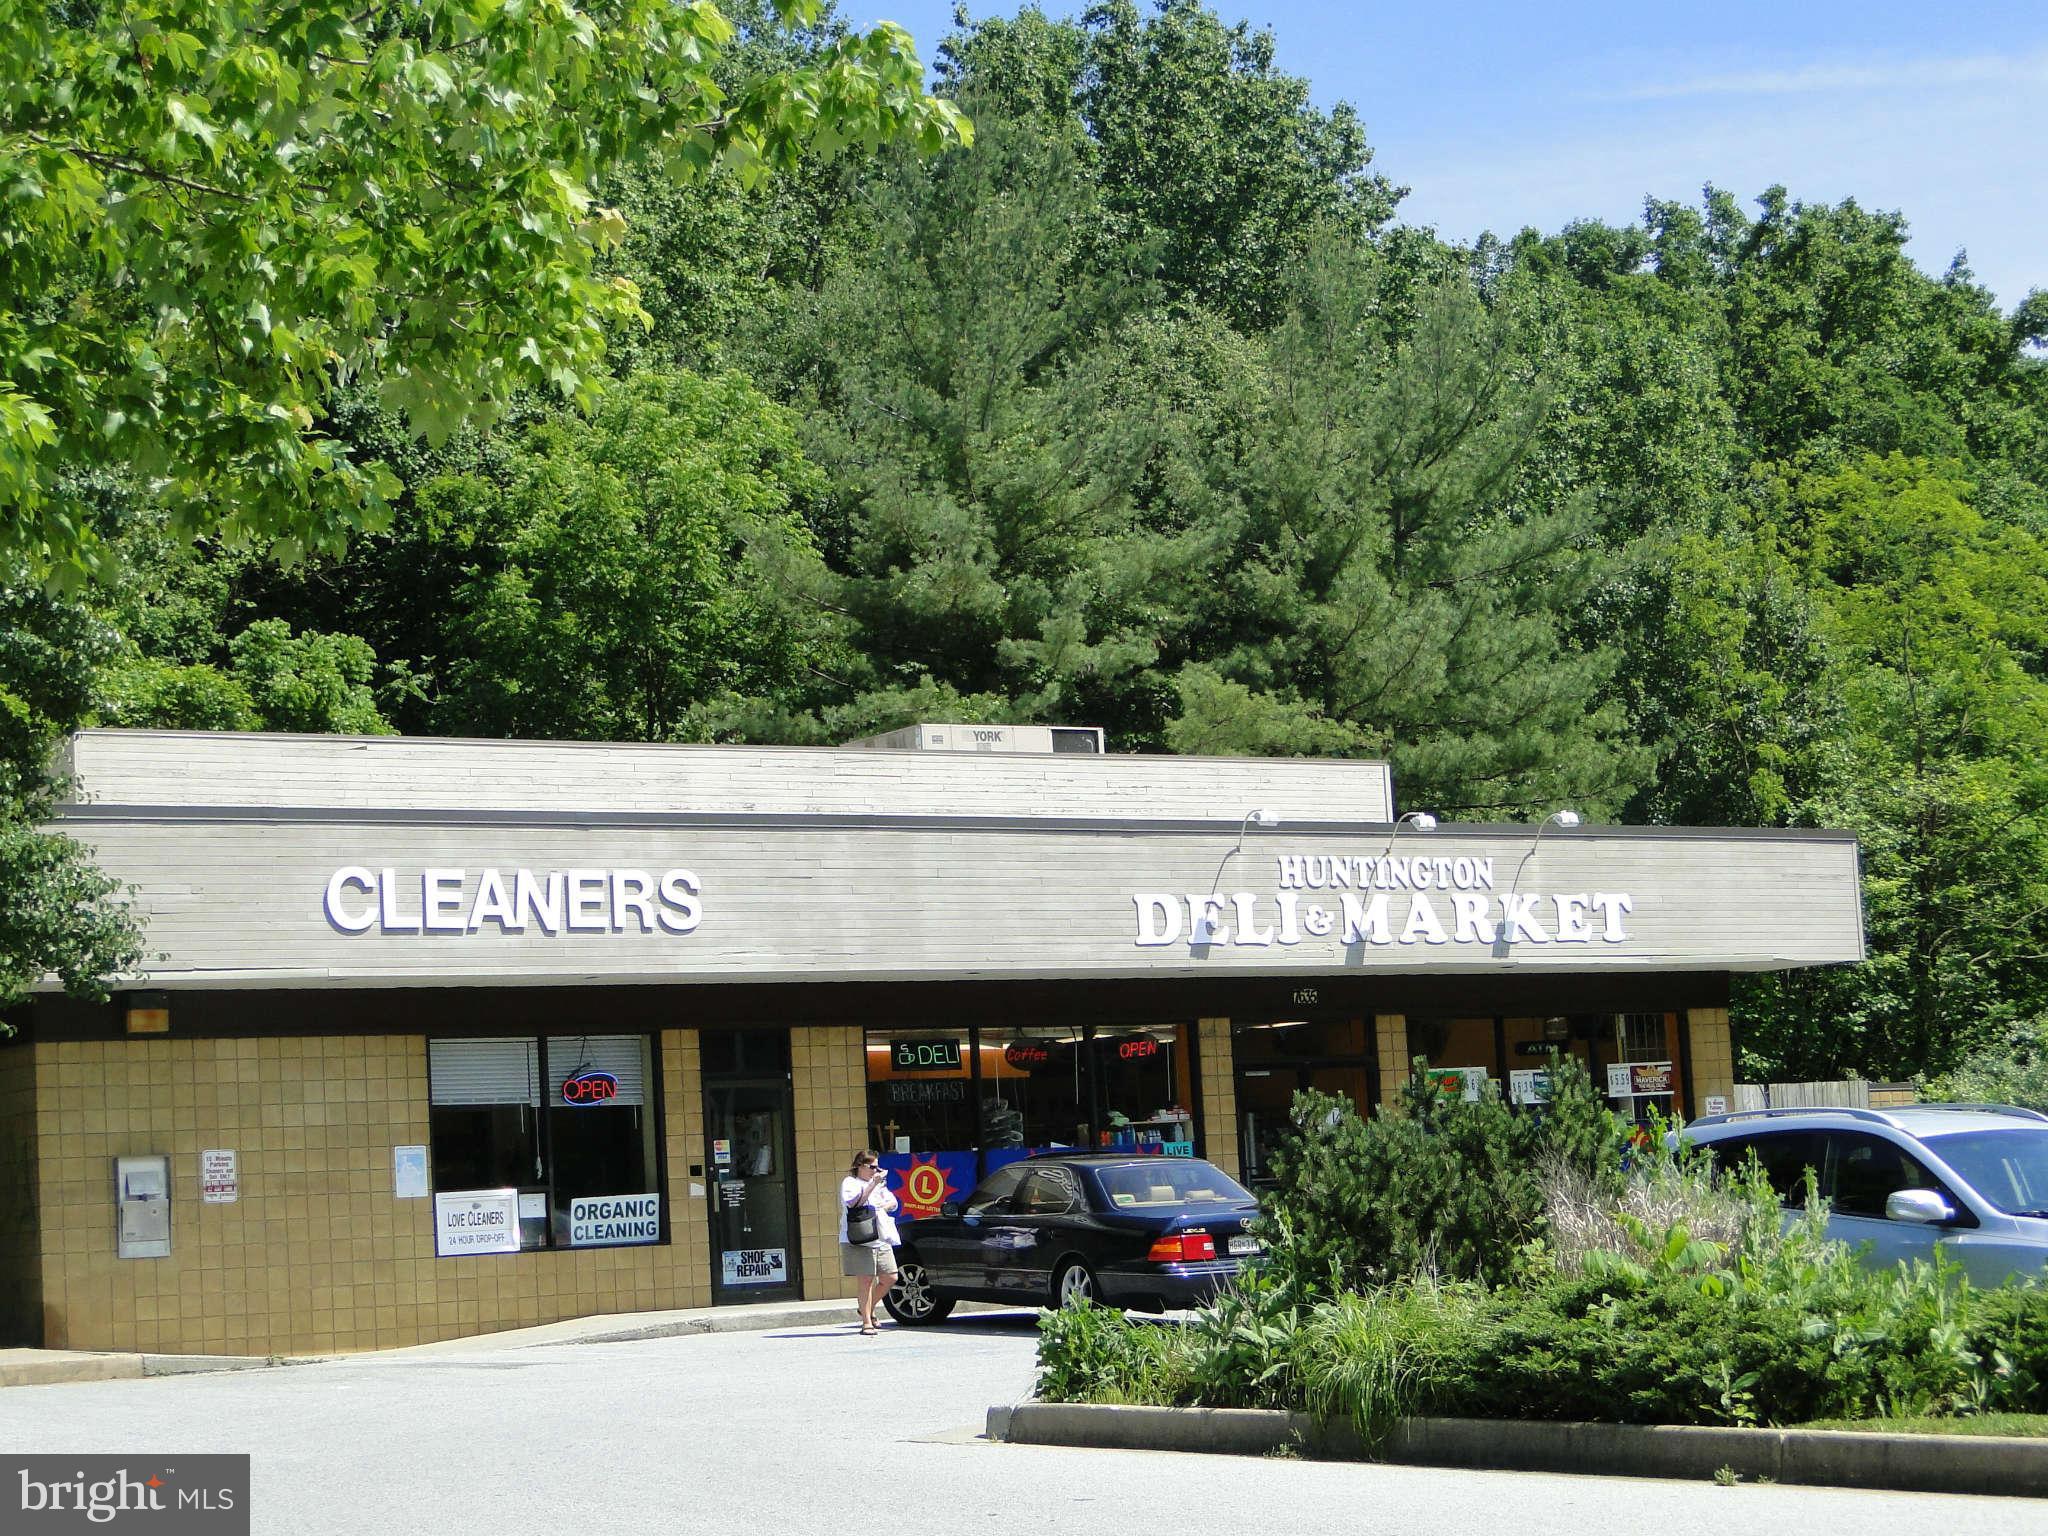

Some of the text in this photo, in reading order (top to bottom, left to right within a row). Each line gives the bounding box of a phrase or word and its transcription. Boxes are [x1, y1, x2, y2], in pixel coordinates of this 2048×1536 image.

[973, 730, 1001, 742] YORK
[1277, 855, 1494, 891] HUNTINGTON
[324, 866, 703, 937] CLEANERS
[1133, 893, 1302, 947] DELI
[1339, 892, 1633, 946] MARKET
[918, 1043, 961, 1065] DELI
[1006, 1047, 1049, 1063] Coffee
[1120, 1040, 1157, 1059] OPEN
[1635, 1074, 1668, 1084] MAVERICK
[563, 1079, 618, 1100] OPEN
[892, 1081, 966, 1101] BREAKFAST
[1166, 1144, 1190, 1156] LIVE
[574, 1200, 657, 1221] ORGANIC
[926, 1205, 942, 1213] LOTTER
[447, 1210, 504, 1227] LOVE CLEANERS
[448, 1231, 505, 1246] 24 HOUR DROP-OFF
[573, 1221, 658, 1241] CLEANING
[1182, 1226, 1206, 1234] LEXUS
[740, 1250, 766, 1265] SHOE
[736, 1264, 771, 1278] REPAIR
